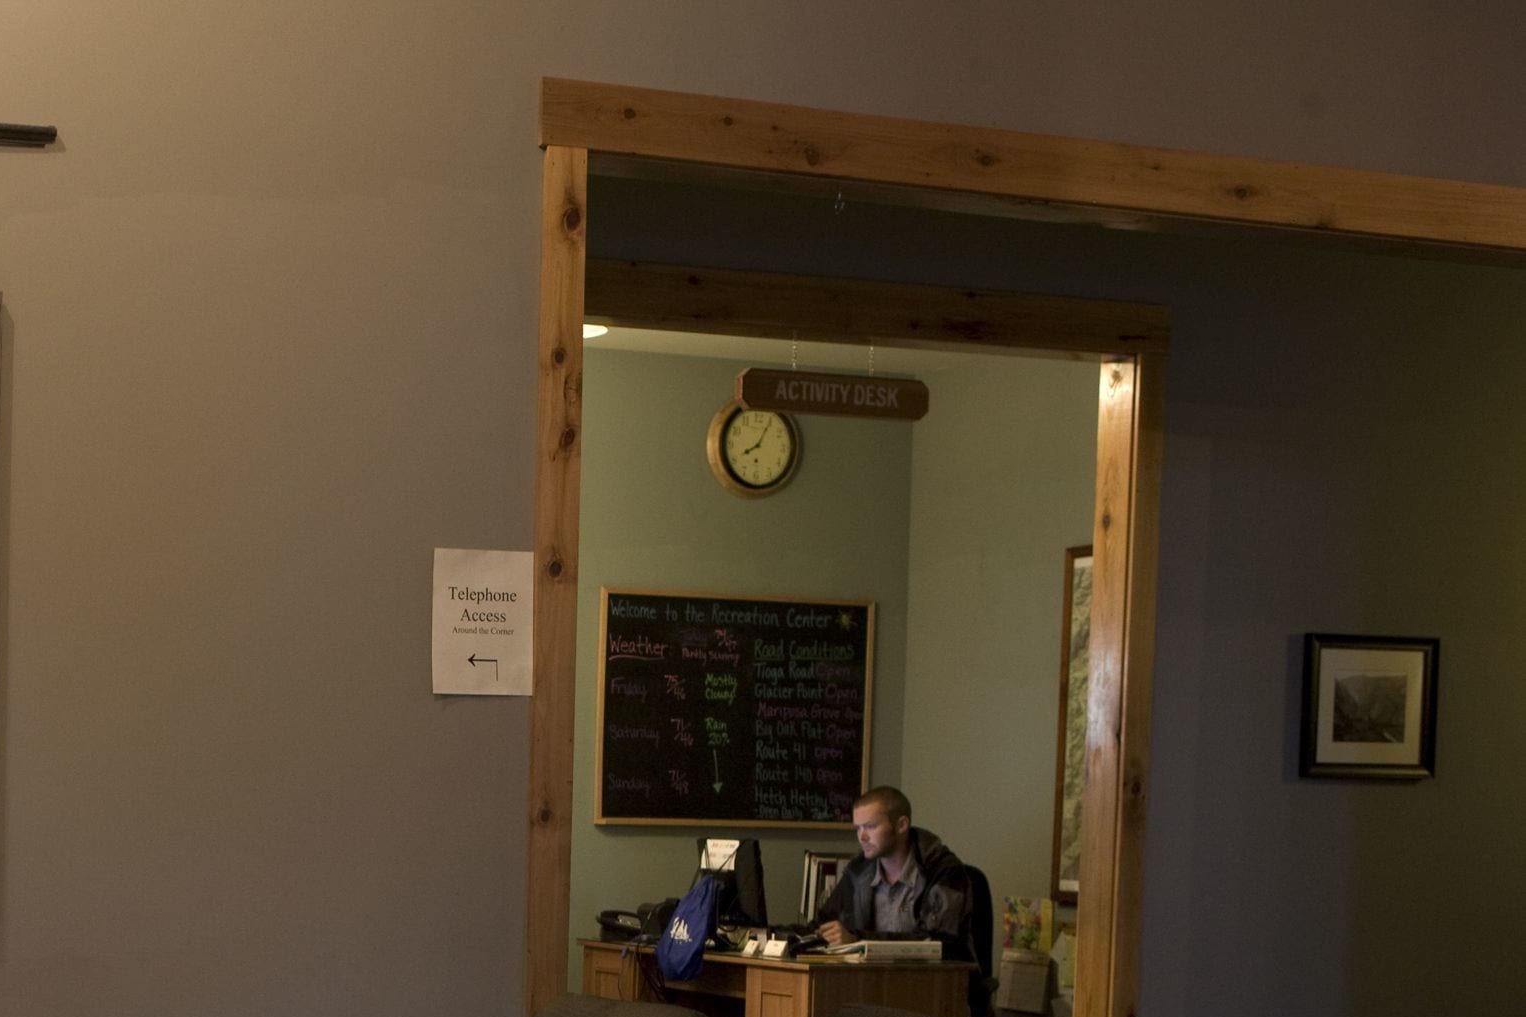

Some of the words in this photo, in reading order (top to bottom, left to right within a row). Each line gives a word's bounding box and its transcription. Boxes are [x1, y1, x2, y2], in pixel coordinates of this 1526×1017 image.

[775, 380, 850, 403] ACTIVITY
[853, 385, 899, 408] DESK
[448, 586, 517, 605] Telephone
[460, 609, 507, 623] Access
[610, 598, 658, 620] Welcome
[665, 602, 679, 622] to
[684, 602, 705, 623] the
[712, 603, 780, 627] Recreation
[786, 607, 832, 629] Center
[452, 626, 478, 635] Around
[479, 627, 489, 635] the
[490, 628, 515, 636] Corner
[609, 632, 667, 657] Weather
[754, 638, 783, 658] Road
[789, 640, 855, 658] Conditions
[754, 661, 784, 685] Tioga
[788, 660, 815, 680] Road
[755, 683, 794, 699] Glacier
[704, 716, 727, 731] Rain
